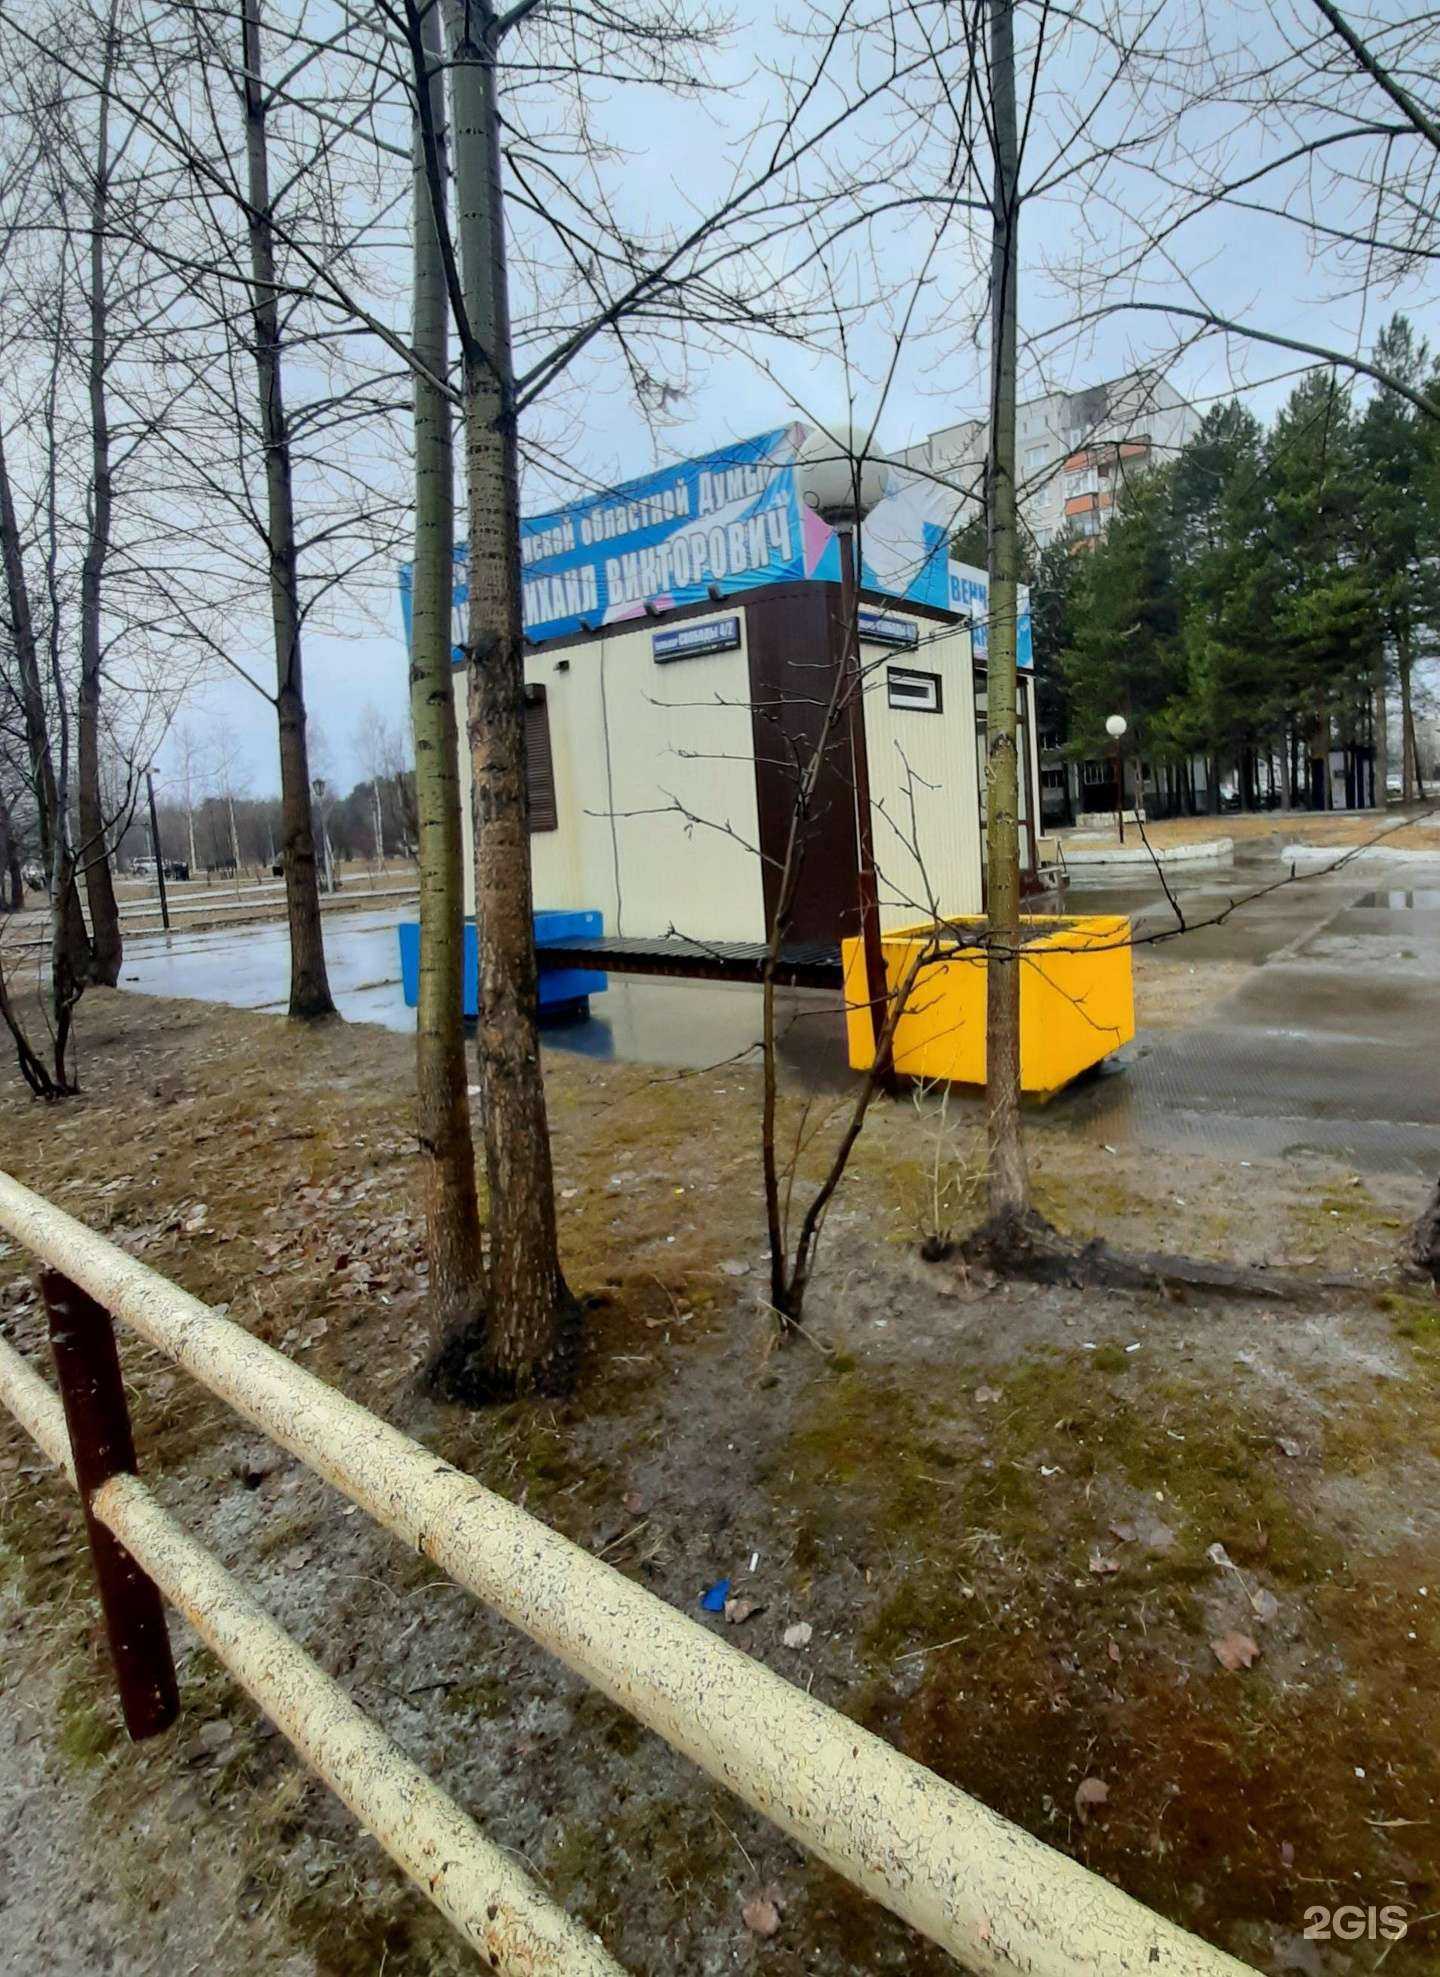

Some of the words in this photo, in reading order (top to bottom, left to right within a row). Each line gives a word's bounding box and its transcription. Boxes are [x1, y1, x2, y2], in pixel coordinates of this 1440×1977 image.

[580, 478, 690, 546] областной
[697, 463, 770, 515] Думы
[522, 563, 598, 627] ИХАИЛ
[604, 505, 793, 606] ВИКТОРОВИЧ
